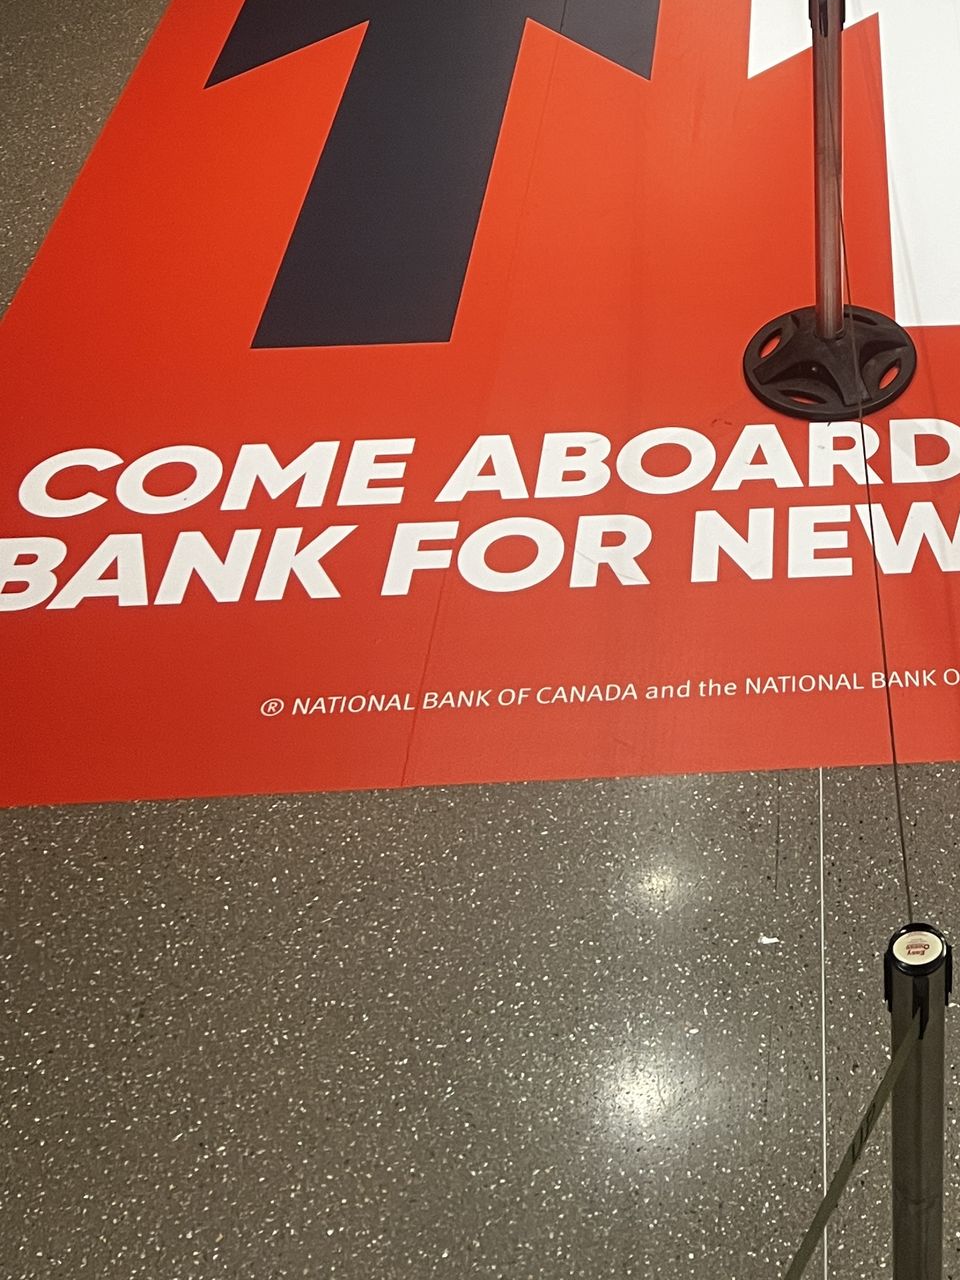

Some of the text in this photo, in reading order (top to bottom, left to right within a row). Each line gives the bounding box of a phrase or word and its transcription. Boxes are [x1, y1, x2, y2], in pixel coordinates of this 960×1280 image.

[18, 437, 416, 518] COME
[0, 524, 358, 612] BANK
[381, 514, 653, 596] FOR
[292, 693, 416, 716] NATIONAL
[422, 689, 492, 709] BANK
[498, 687, 532, 706] OF
[535, 683, 638, 704] CANADA
[645, 680, 691, 700] and
[698, 679, 738, 698] the
[745, 673, 865, 695] NATIONAL
[871, 669, 936, 689] BANK
